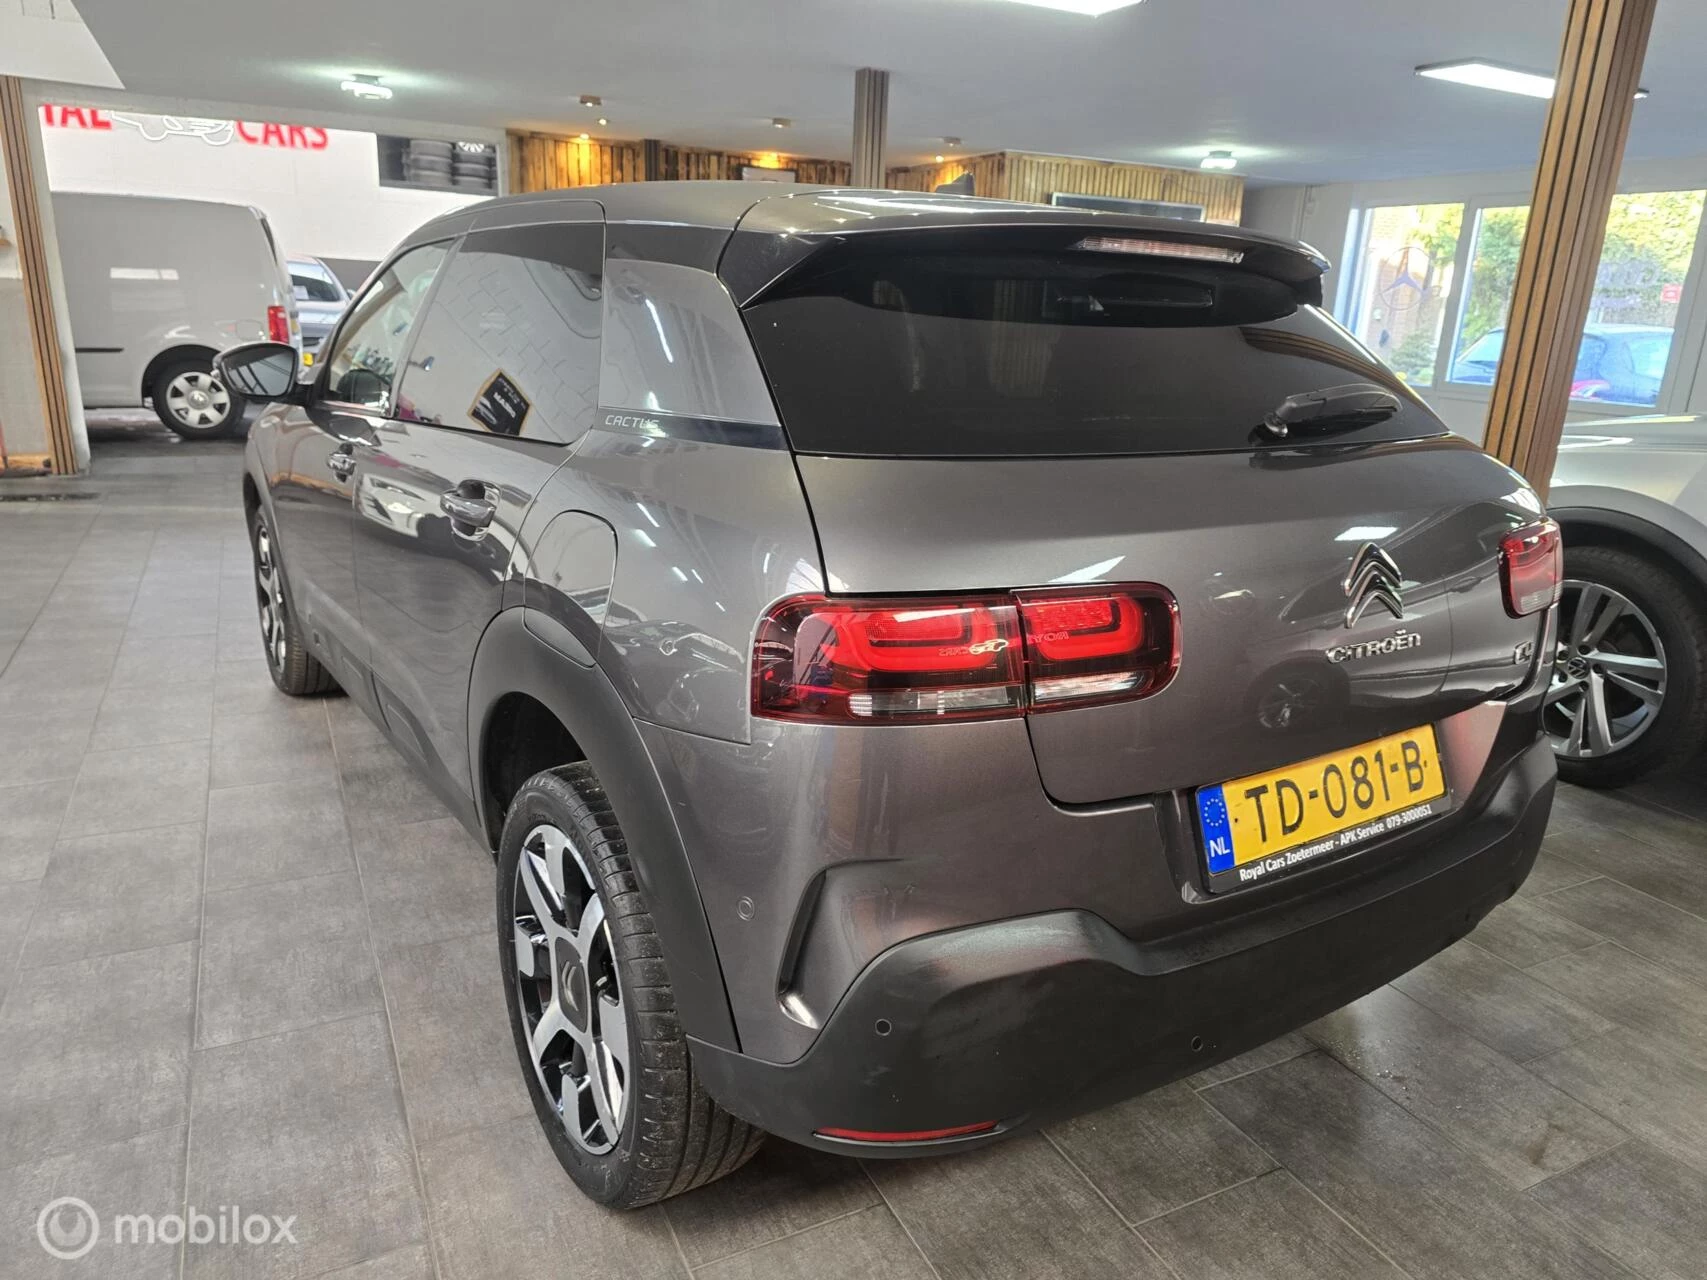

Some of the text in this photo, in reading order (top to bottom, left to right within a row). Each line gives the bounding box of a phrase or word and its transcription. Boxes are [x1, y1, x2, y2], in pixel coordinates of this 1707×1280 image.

[604, 414, 660, 429] CACTUS
[1245, 740, 1425, 842] TD-081-B
[1209, 838, 1230, 858] NL
[1239, 861, 1265, 881] Royal
[1266, 857, 1285, 871] Cars
[1285, 840, 1334, 864] Zoetermeer
[1340, 829, 1356, 845] APK
[1357, 822, 1384, 839] Service
[1386, 804, 1432, 829] 079-3000051
